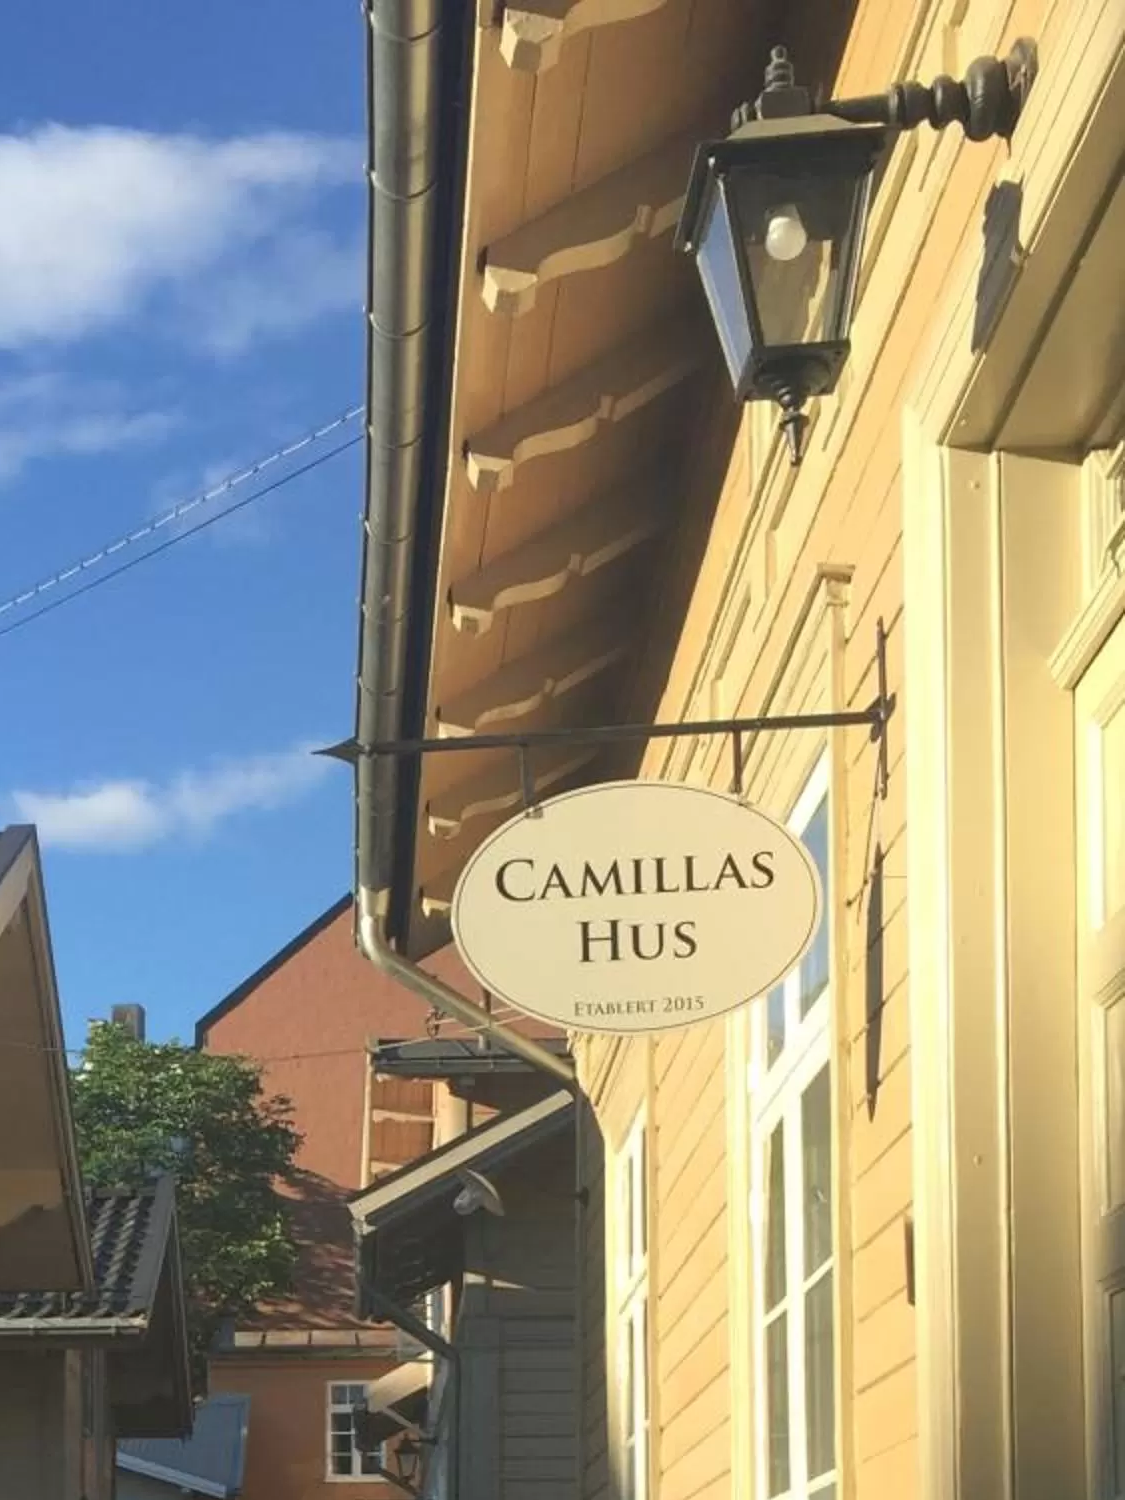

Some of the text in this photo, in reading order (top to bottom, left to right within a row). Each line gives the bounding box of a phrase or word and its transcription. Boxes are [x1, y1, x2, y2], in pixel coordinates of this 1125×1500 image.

[495, 851, 775, 902] CAMILLAS
[577, 919, 697, 963] HUS
[662, 995, 705, 1014] 2015
